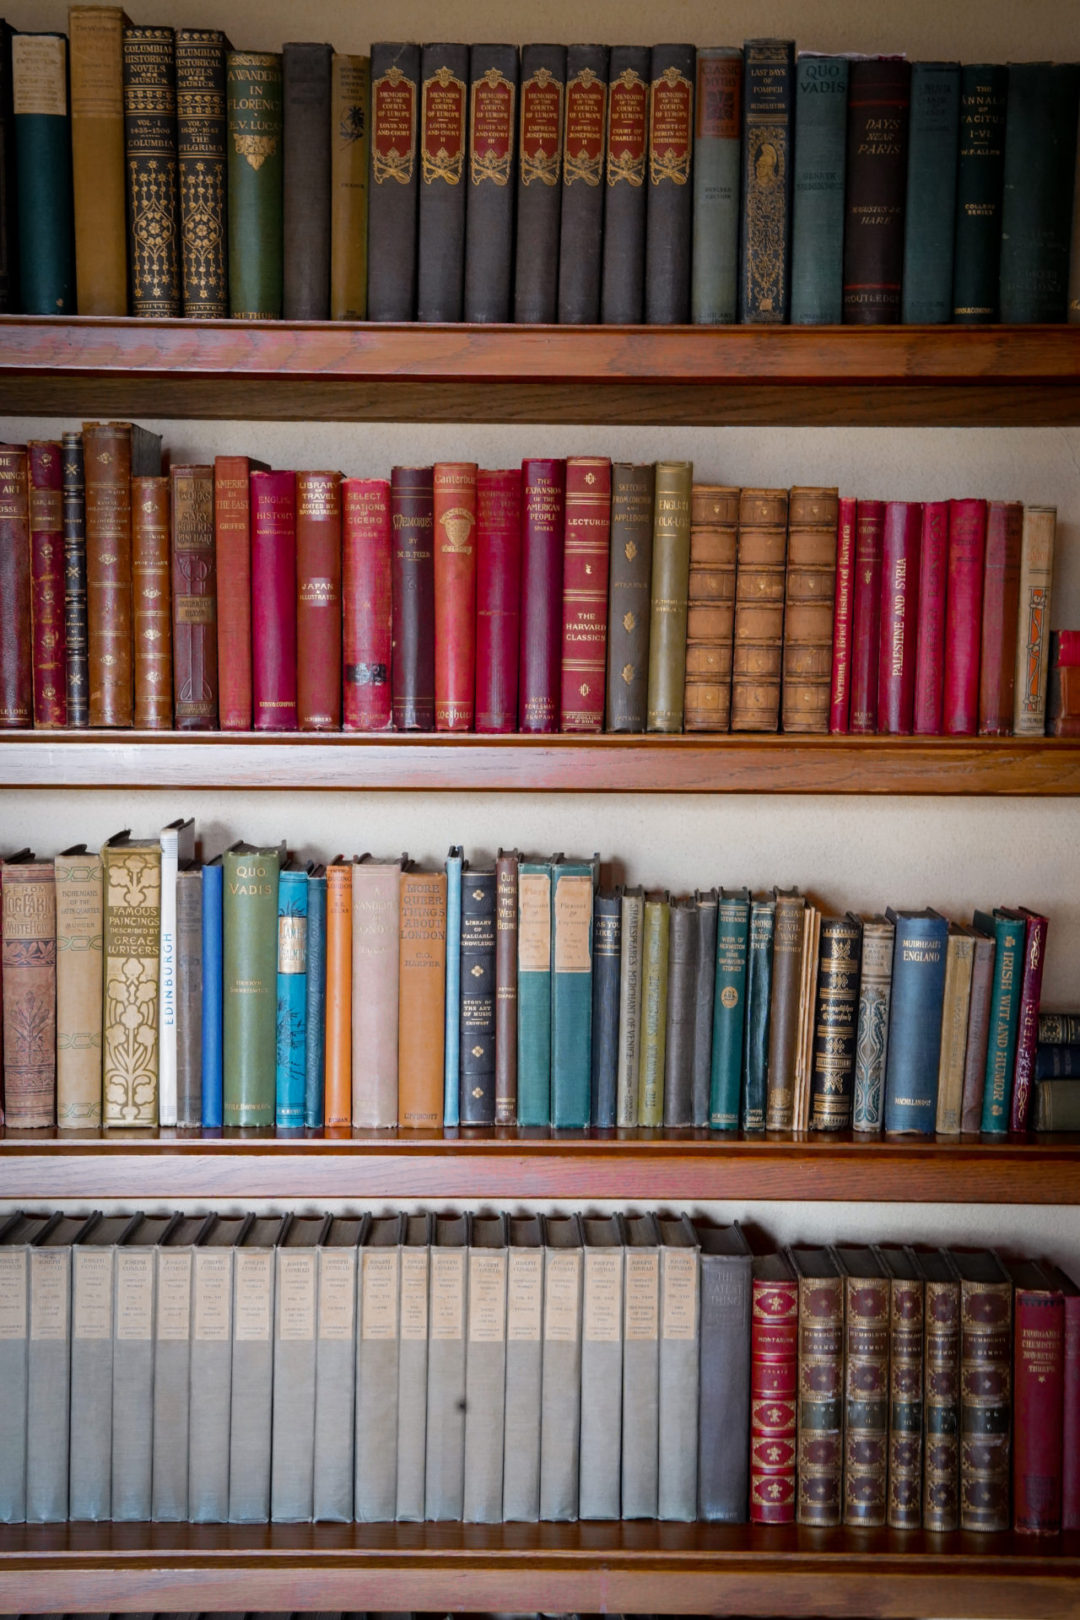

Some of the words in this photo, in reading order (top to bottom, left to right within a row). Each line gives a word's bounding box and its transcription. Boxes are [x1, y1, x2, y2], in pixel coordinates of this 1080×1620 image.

[130, 64, 166, 73] NOVELS
[805, 64, 840, 81] QUO
[249, 85, 264, 96] IN
[800, 81, 847, 95] VADIS
[2, 485, 21, 494] ART
[302, 492, 337, 500] TRAVEL
[567, 518, 610, 526] LECTURES
[895, 557, 908, 591] SYRIA
[301, 582, 334, 591] JAPAN
[893, 595, 906, 618] AND
[577, 612, 596, 621] THE
[565, 622, 607, 631] HARVARD
[565, 632, 607, 642] CLASSICS
[837, 623, 849, 649] Brief
[890, 621, 905, 677] PALESTINE
[837, 650, 847, 661] A
[235, 865, 267, 878] QUO
[228, 882, 273, 896] VADIS
[406, 884, 441, 893] MORE
[403, 896, 443, 906] QUEER
[112, 906, 158, 917] FAMOUS
[402, 907, 446, 917] THINGS
[404, 920, 443, 929] ABOUT
[465, 919, 492, 927] LIBRARY
[149, 927, 160, 936] BY
[401, 931, 446, 941] LONDON
[114, 936, 156, 945] GREAT
[108, 946, 160, 956] WRITERS
[902, 950, 941, 962] ENGLAND
[1001, 951, 1016, 990] IRISH
[163, 931, 175, 1028] EDINBURGH
[1000, 994, 1013, 1021] WIT
[626, 1017, 637, 1030] OF
[997, 1020, 1011, 1049] AND
[625, 1029, 637, 1060] VENICE
[992, 1052, 1008, 1101] HUMOR
